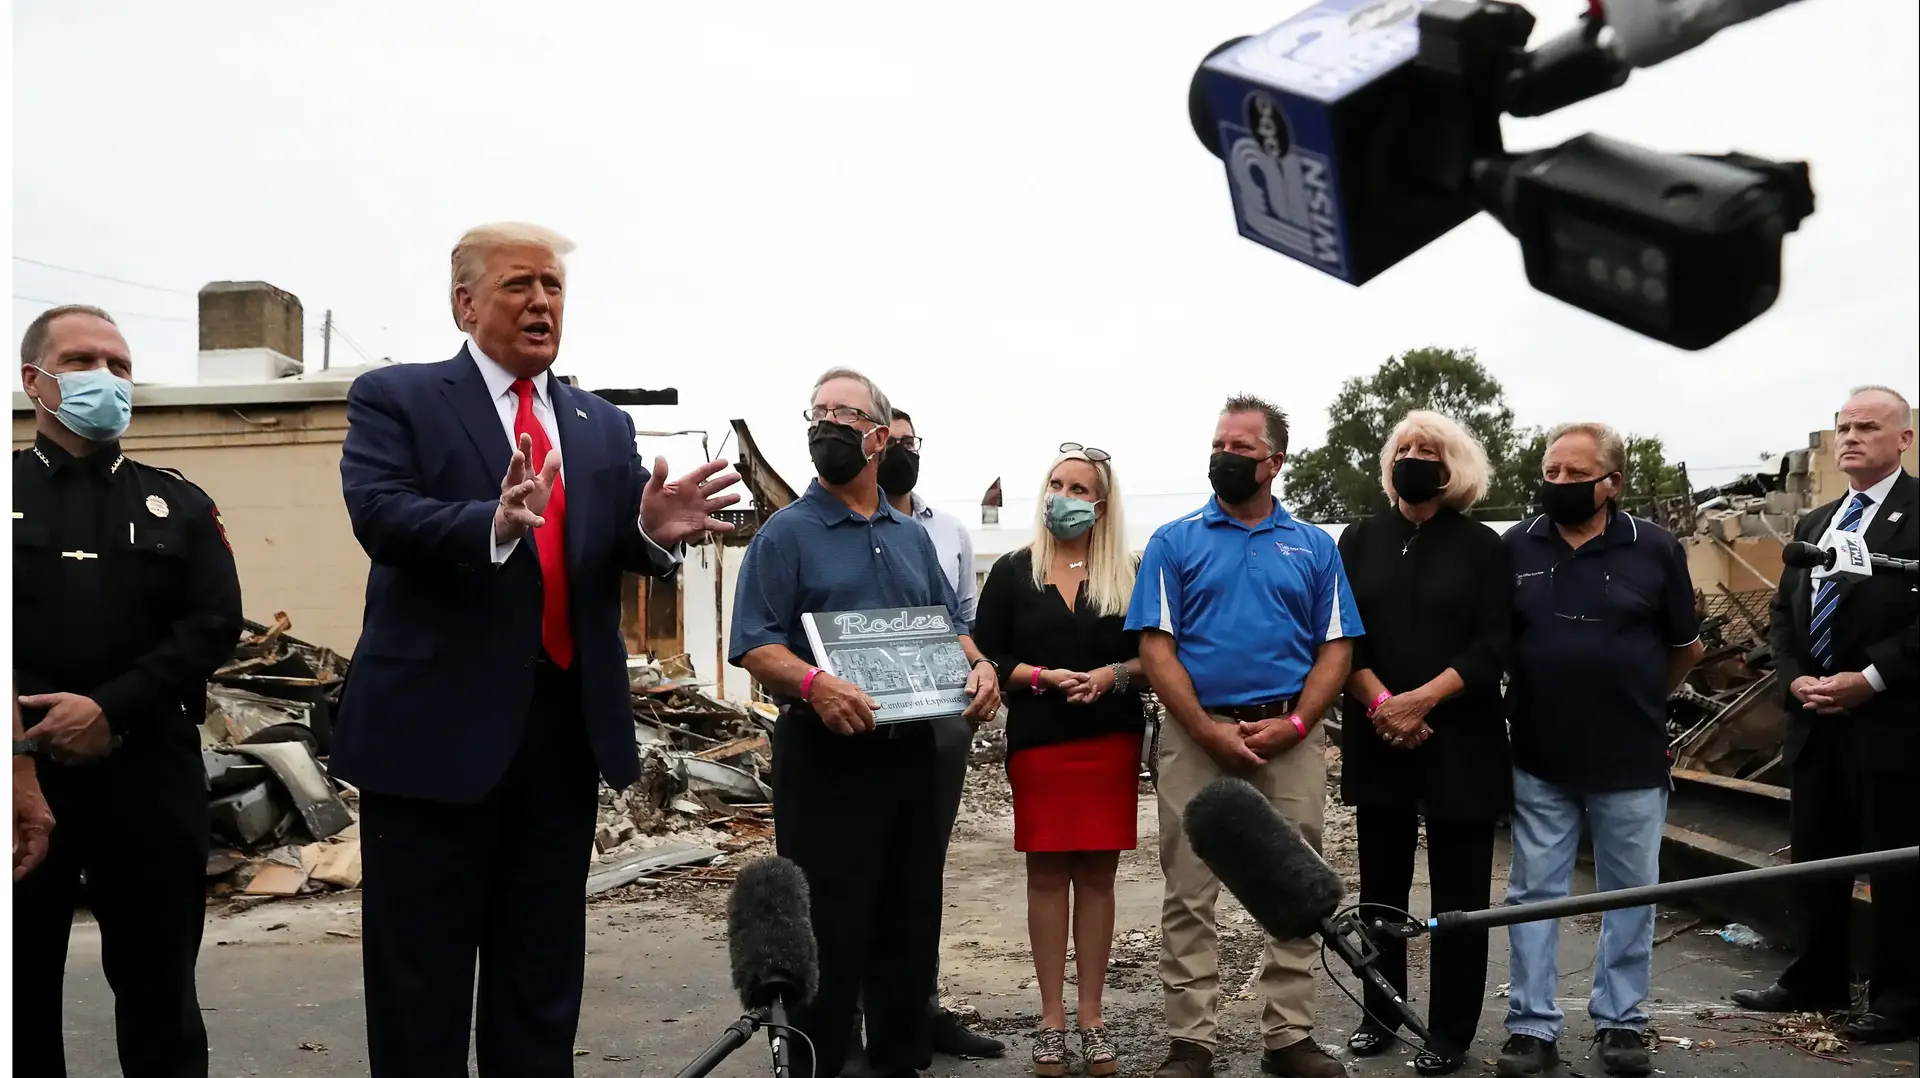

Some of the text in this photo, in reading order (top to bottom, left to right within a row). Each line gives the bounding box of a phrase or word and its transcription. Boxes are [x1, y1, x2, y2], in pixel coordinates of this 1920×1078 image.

[1255, 95, 1280, 157] abc
[1301, 157, 1339, 263] WISN
[834, 610, 950, 635] Rode's
[881, 700, 913, 710] Century
[915, 699, 923, 707] of
